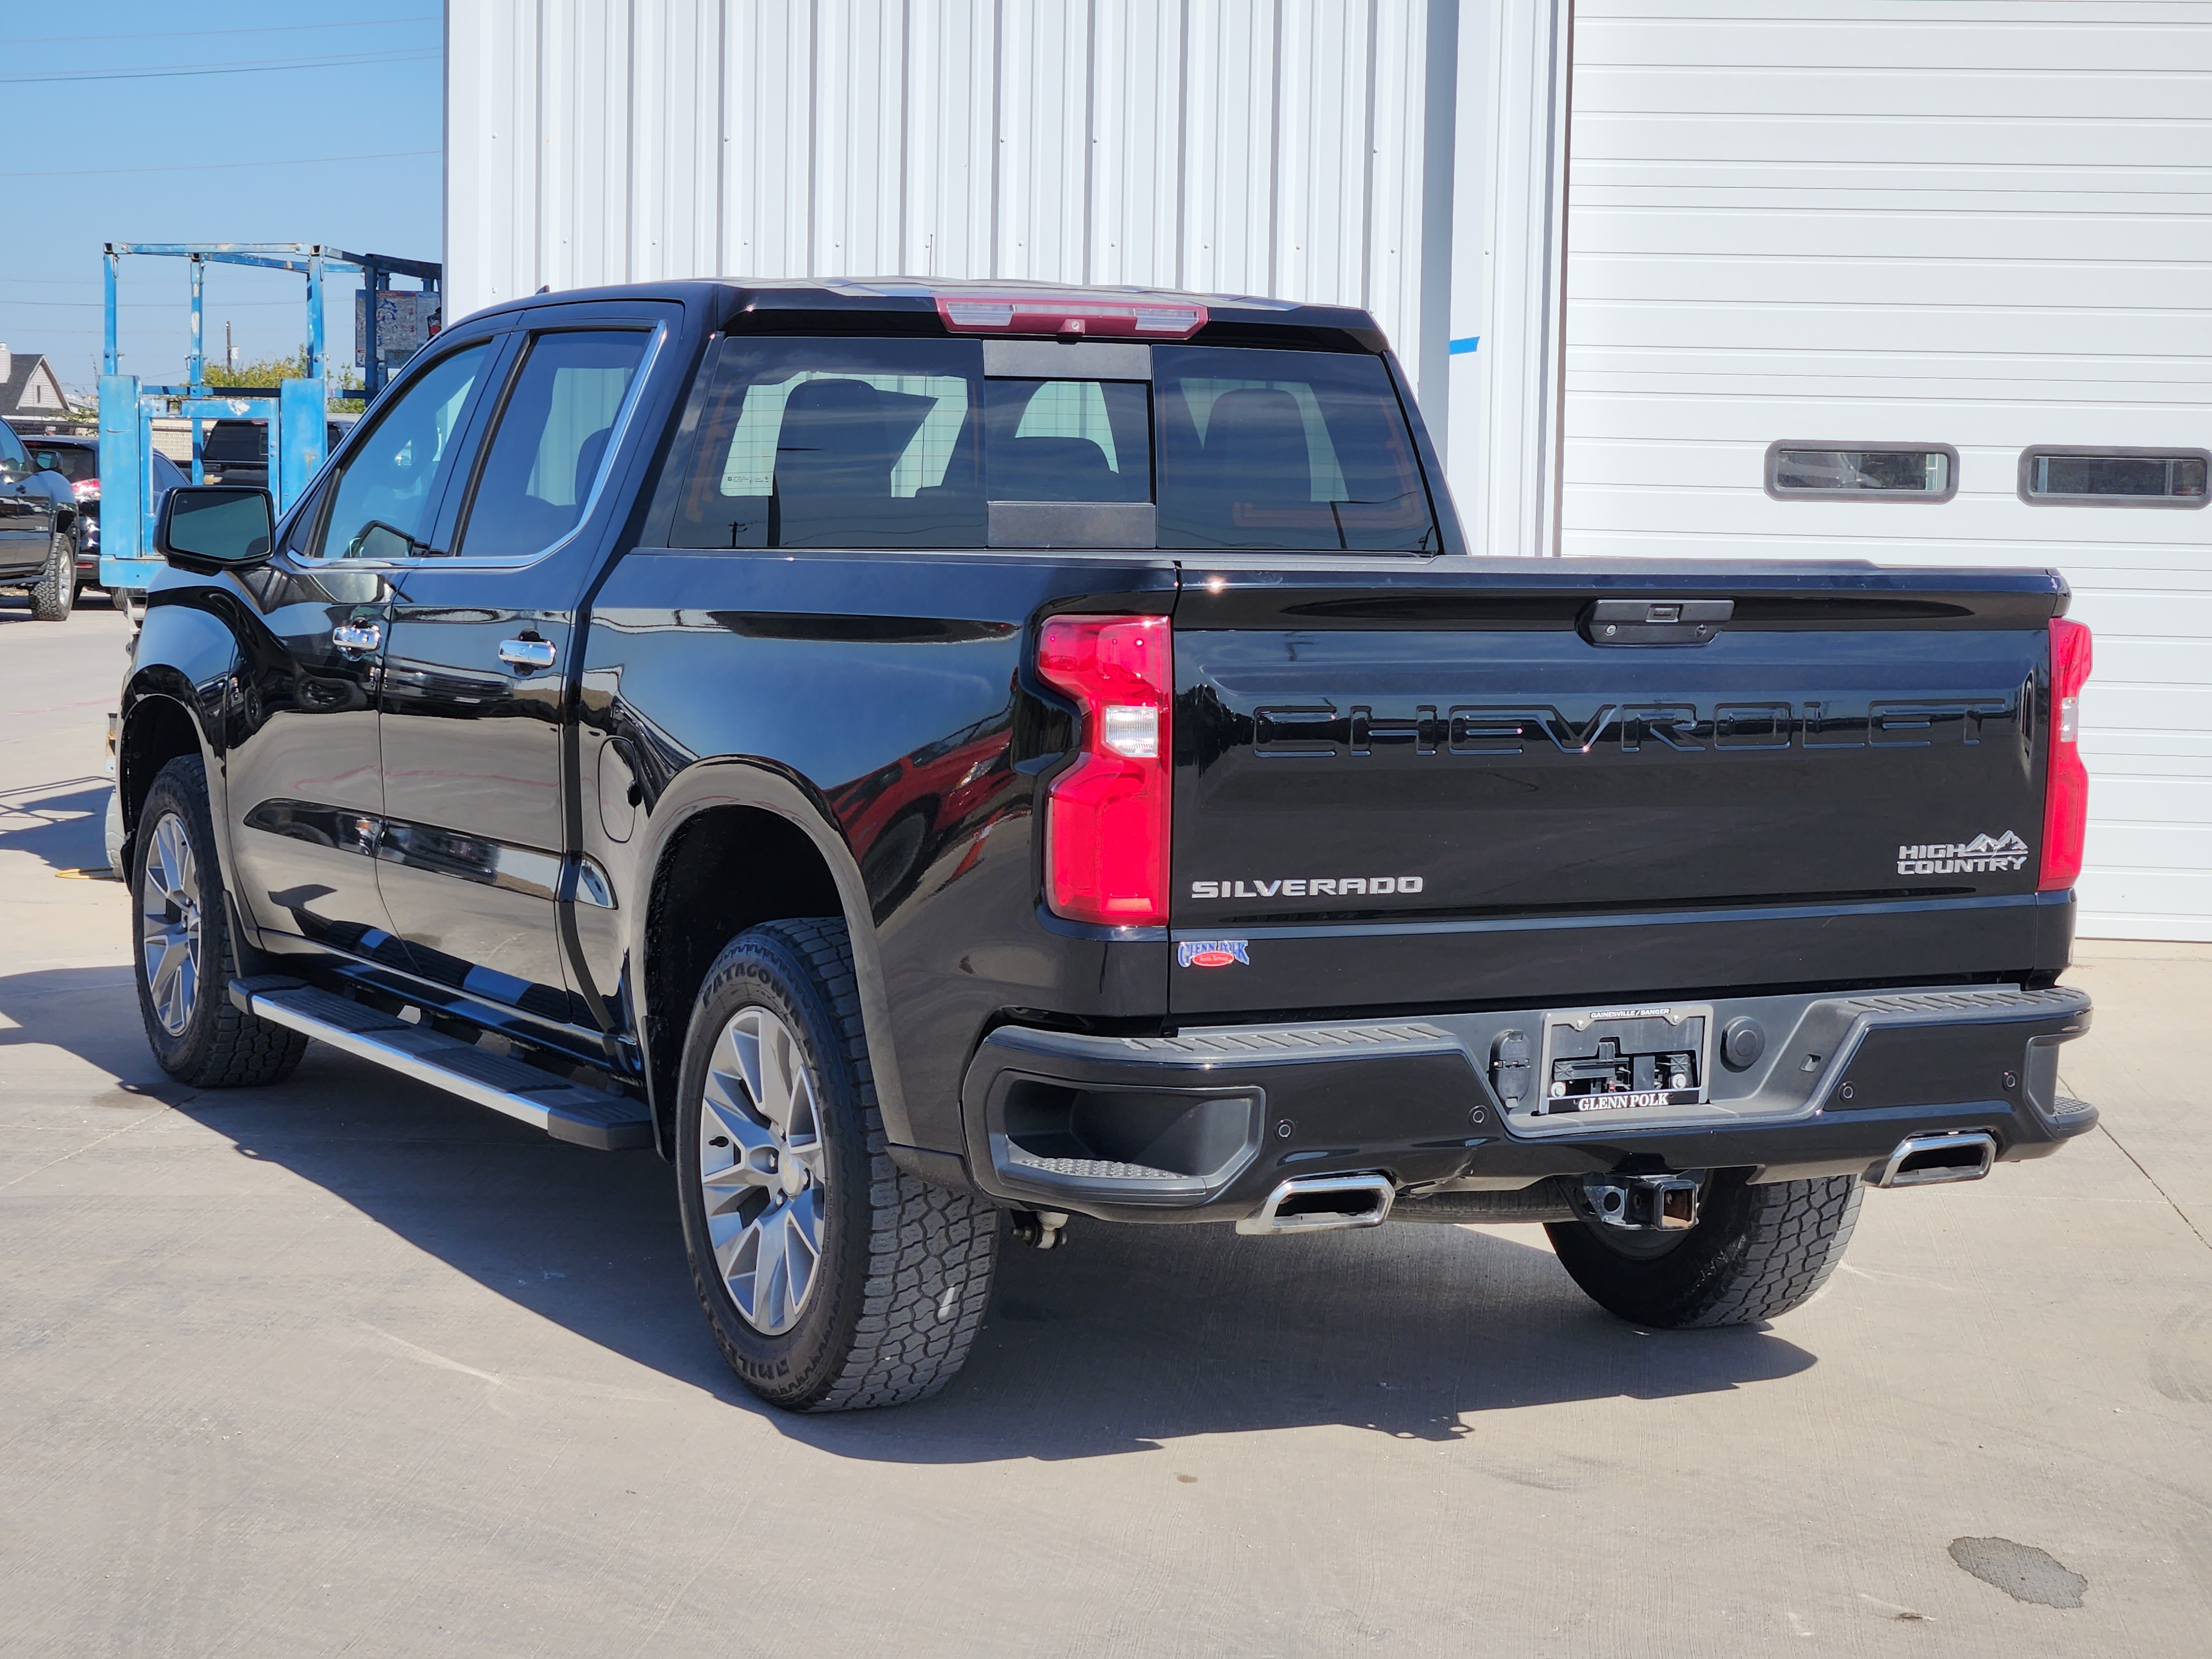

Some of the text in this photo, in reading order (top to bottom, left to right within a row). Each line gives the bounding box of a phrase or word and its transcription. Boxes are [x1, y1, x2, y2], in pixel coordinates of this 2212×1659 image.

[1254, 698, 2005, 758] CHEVROLET
[1898, 843, 1966, 859] HIGH
[1897, 857, 2027, 875] COUNTRY
[1191, 876, 1423, 899] SILVERADO
[1178, 941, 1249, 967] GLENN POLK
[1578, 1092, 1669, 1112] GLENN POLK
